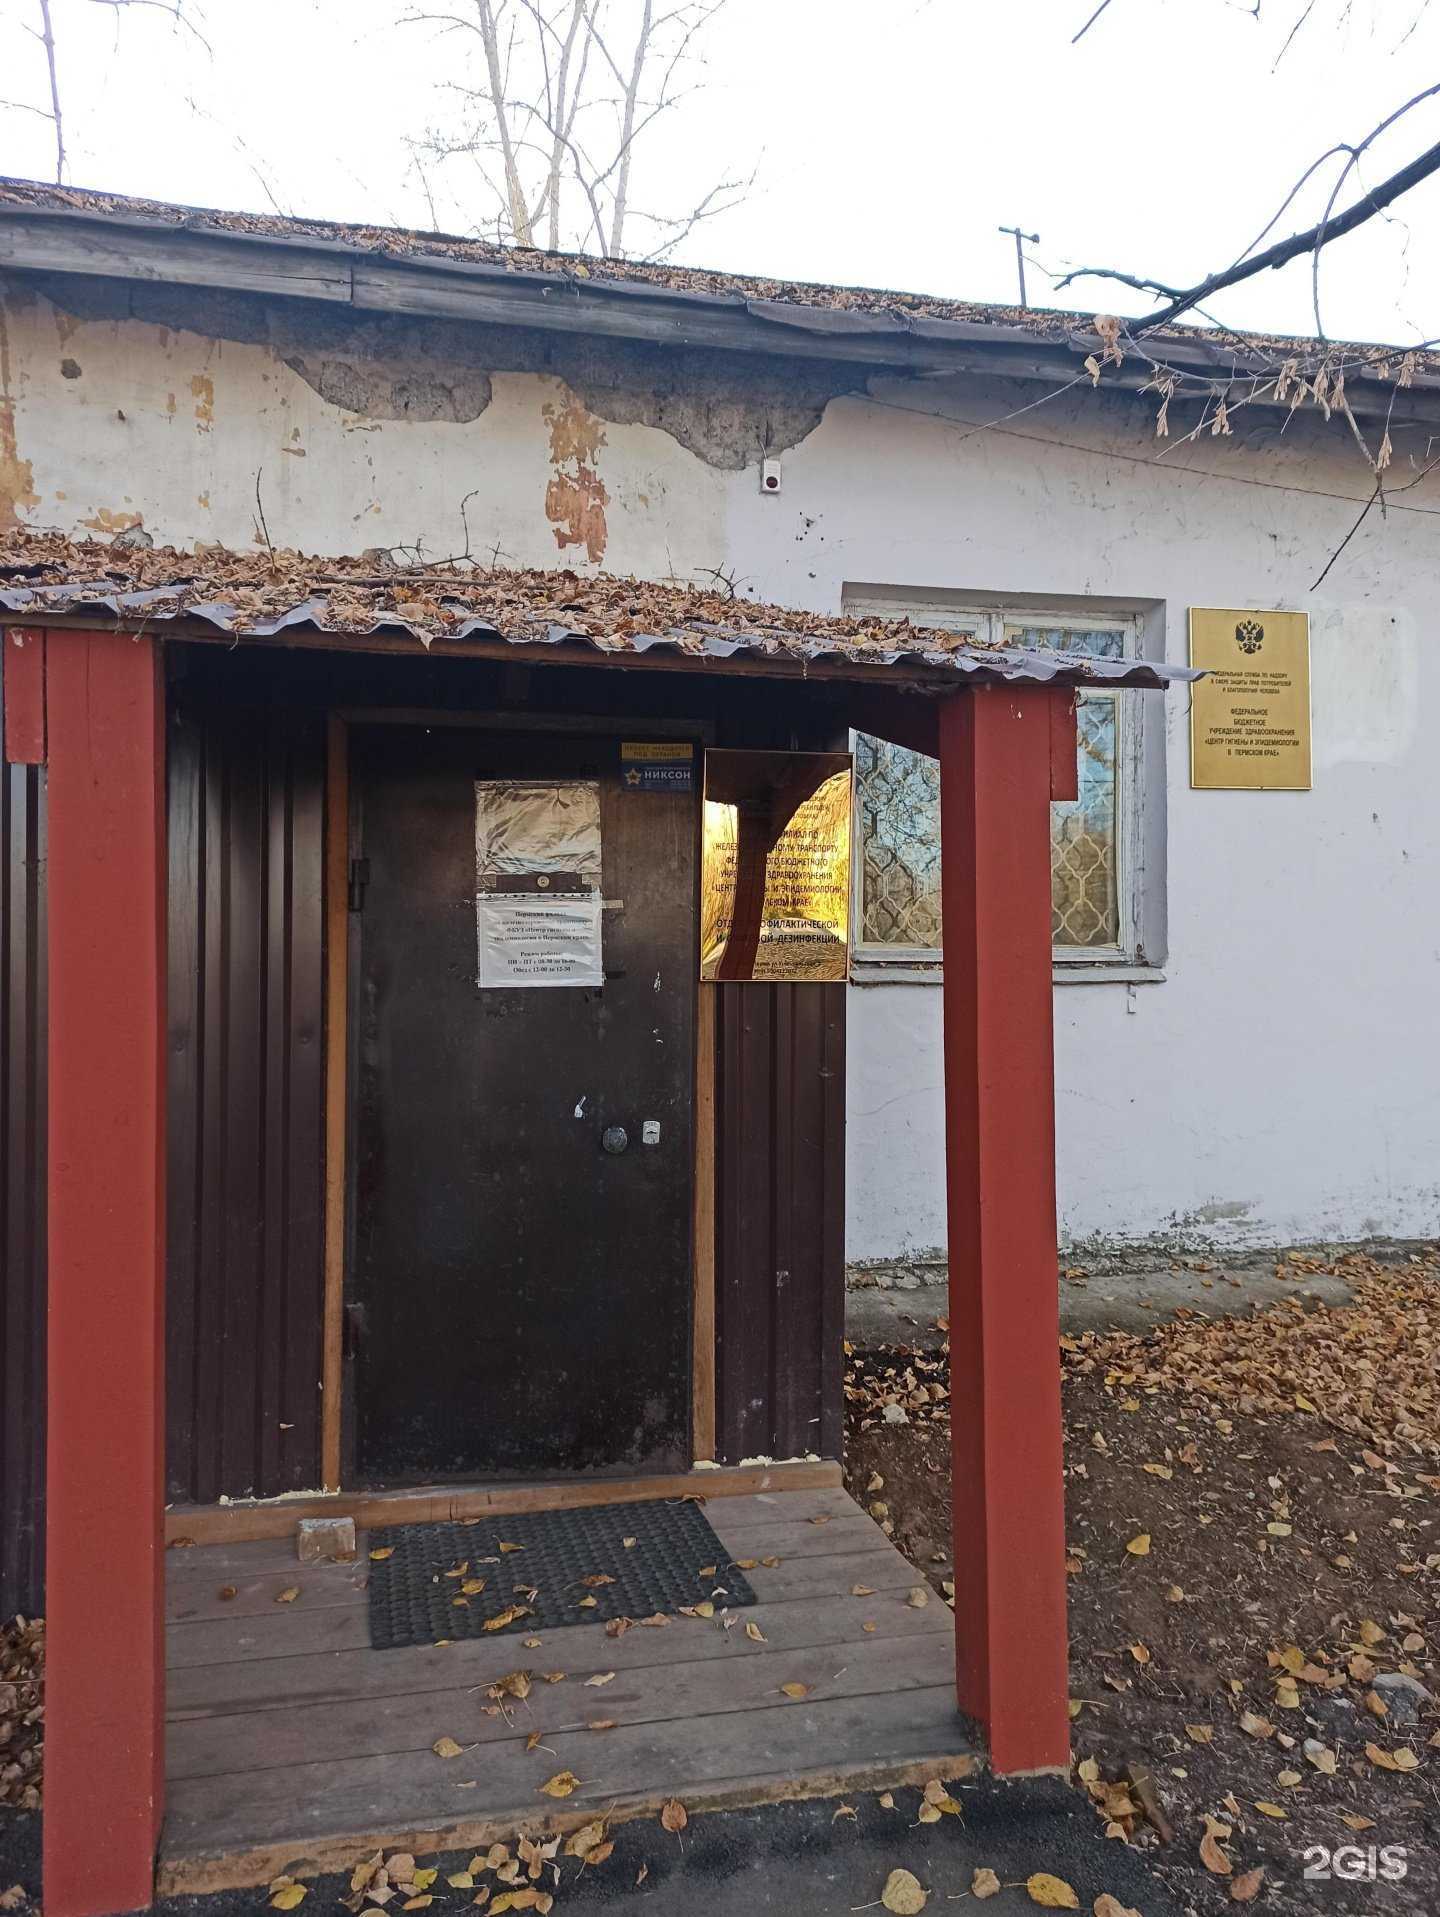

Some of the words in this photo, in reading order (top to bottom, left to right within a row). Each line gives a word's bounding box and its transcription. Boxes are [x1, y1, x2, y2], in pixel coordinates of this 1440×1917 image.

[1233, 718, 1267, 726] БЮДЖЕТНОЕ
[1208, 727, 1243, 735] УЧРЕЖДЕНИЕ
[1245, 728, 1296, 736] ЗДРАВООХРАНЕНИЯ
[1225, 738, 1249, 746] ГИГИЕНЫ
[1235, 749, 1263, 757] ПЕРМСКОМ
[644, 770, 691, 780] НИКСОН
[797, 845, 838, 854] ТРАНСПОРТУ
[780, 857, 829, 867] БЮДЖЕТНОГО
[767, 870, 833, 881] ЗДРАВООХРАНЕНИЯ
[781, 885, 842, 895] ЭПИДЕМИОЛОГИИ
[777, 934, 840, 945] ДЕЗИНФЕКЦИИ
